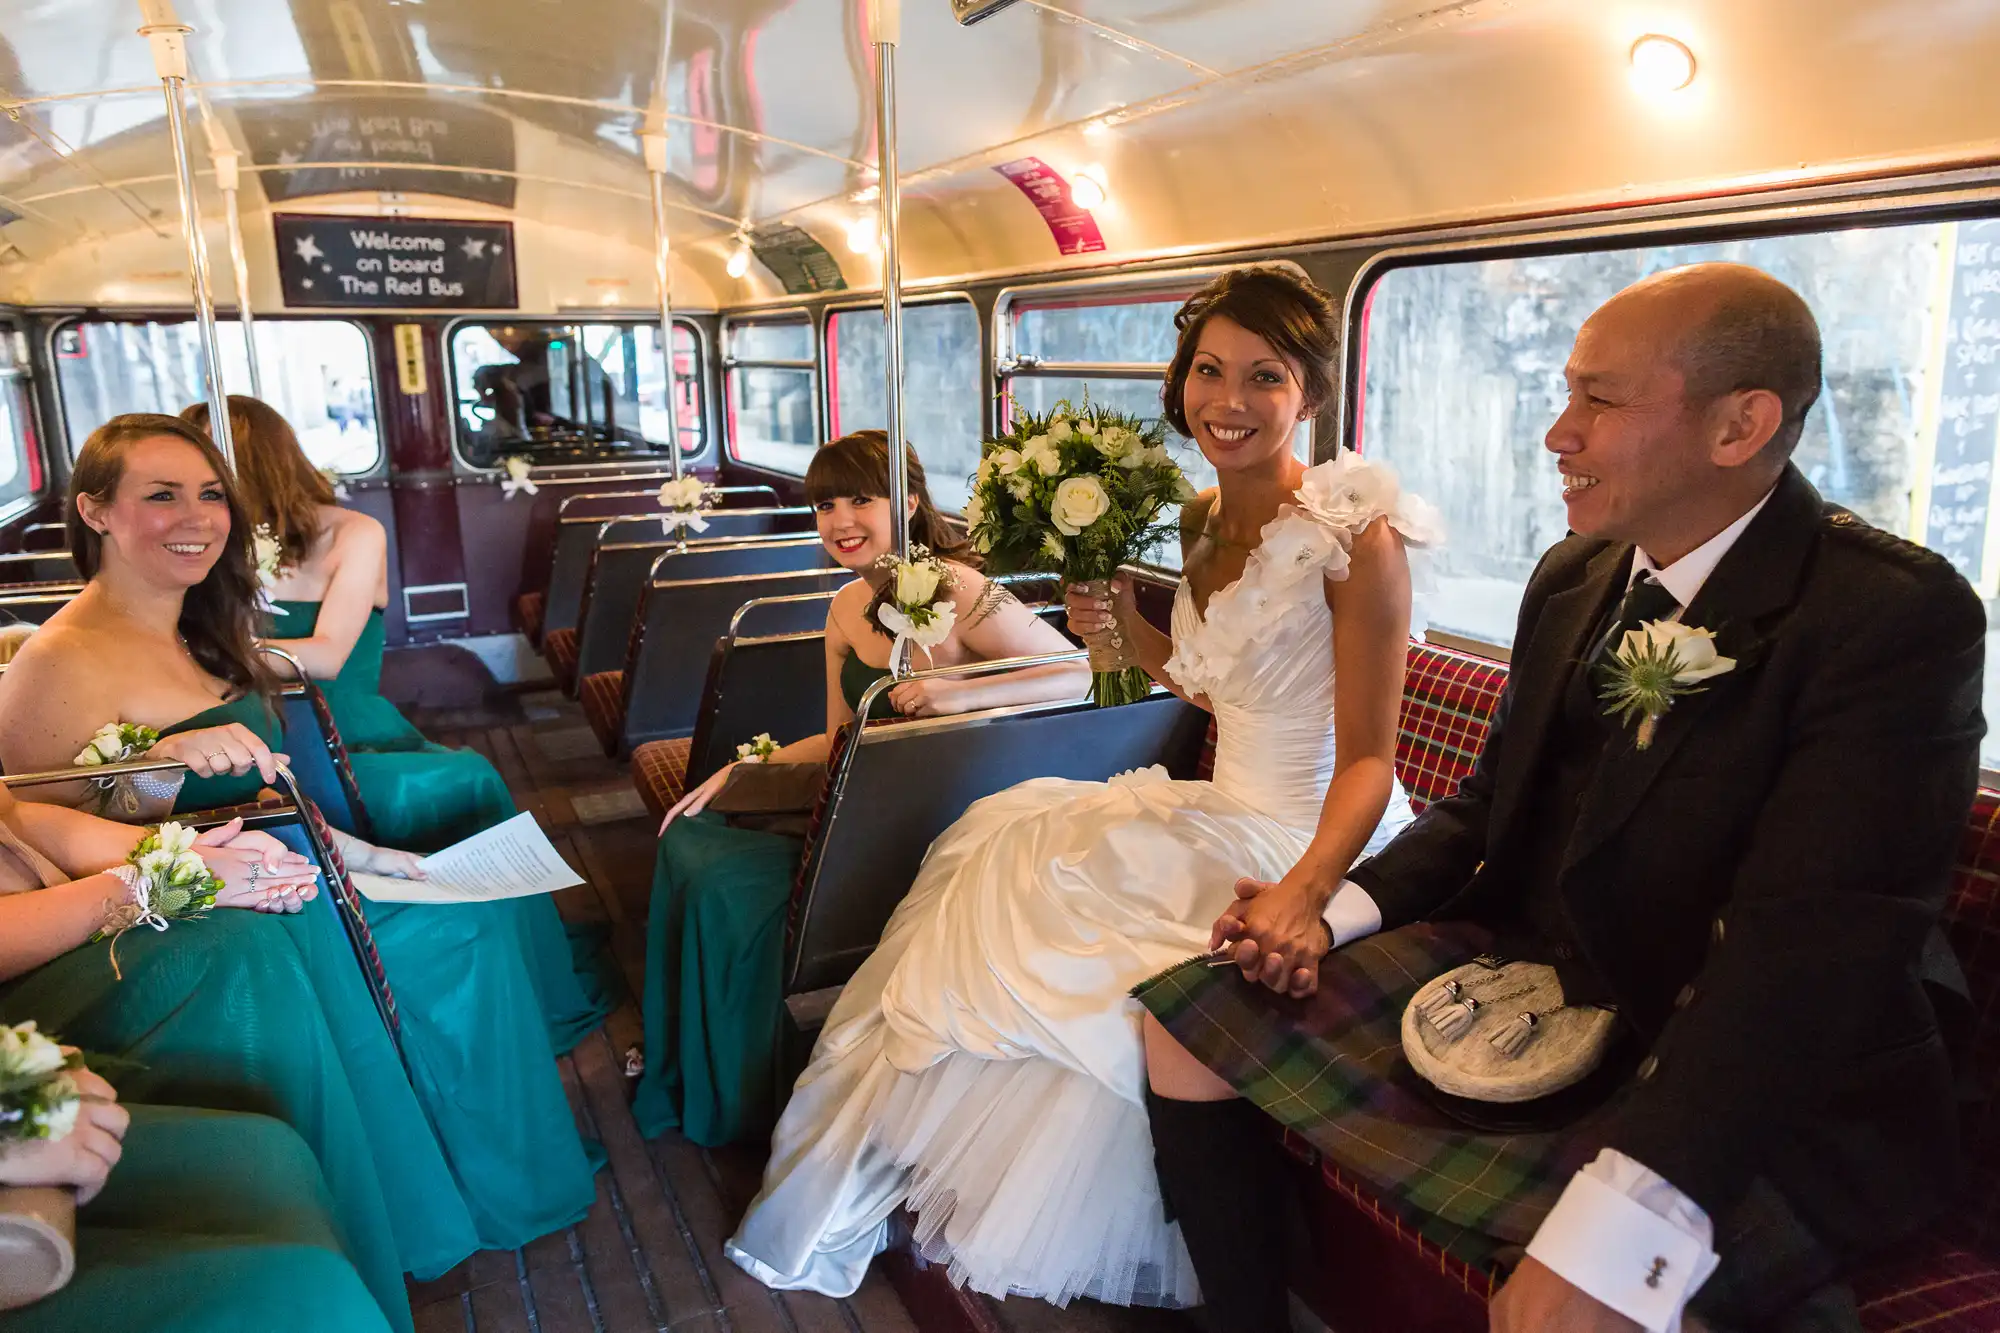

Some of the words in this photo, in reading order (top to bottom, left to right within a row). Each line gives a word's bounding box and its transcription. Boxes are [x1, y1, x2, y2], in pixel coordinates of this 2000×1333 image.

[350, 230, 446, 252] Welcome
[356, 257, 383, 273] on
[387, 253, 445, 274] board
[338, 274, 379, 296] The
[384, 275, 423, 296] Red
[428, 276, 464, 297] Bus
